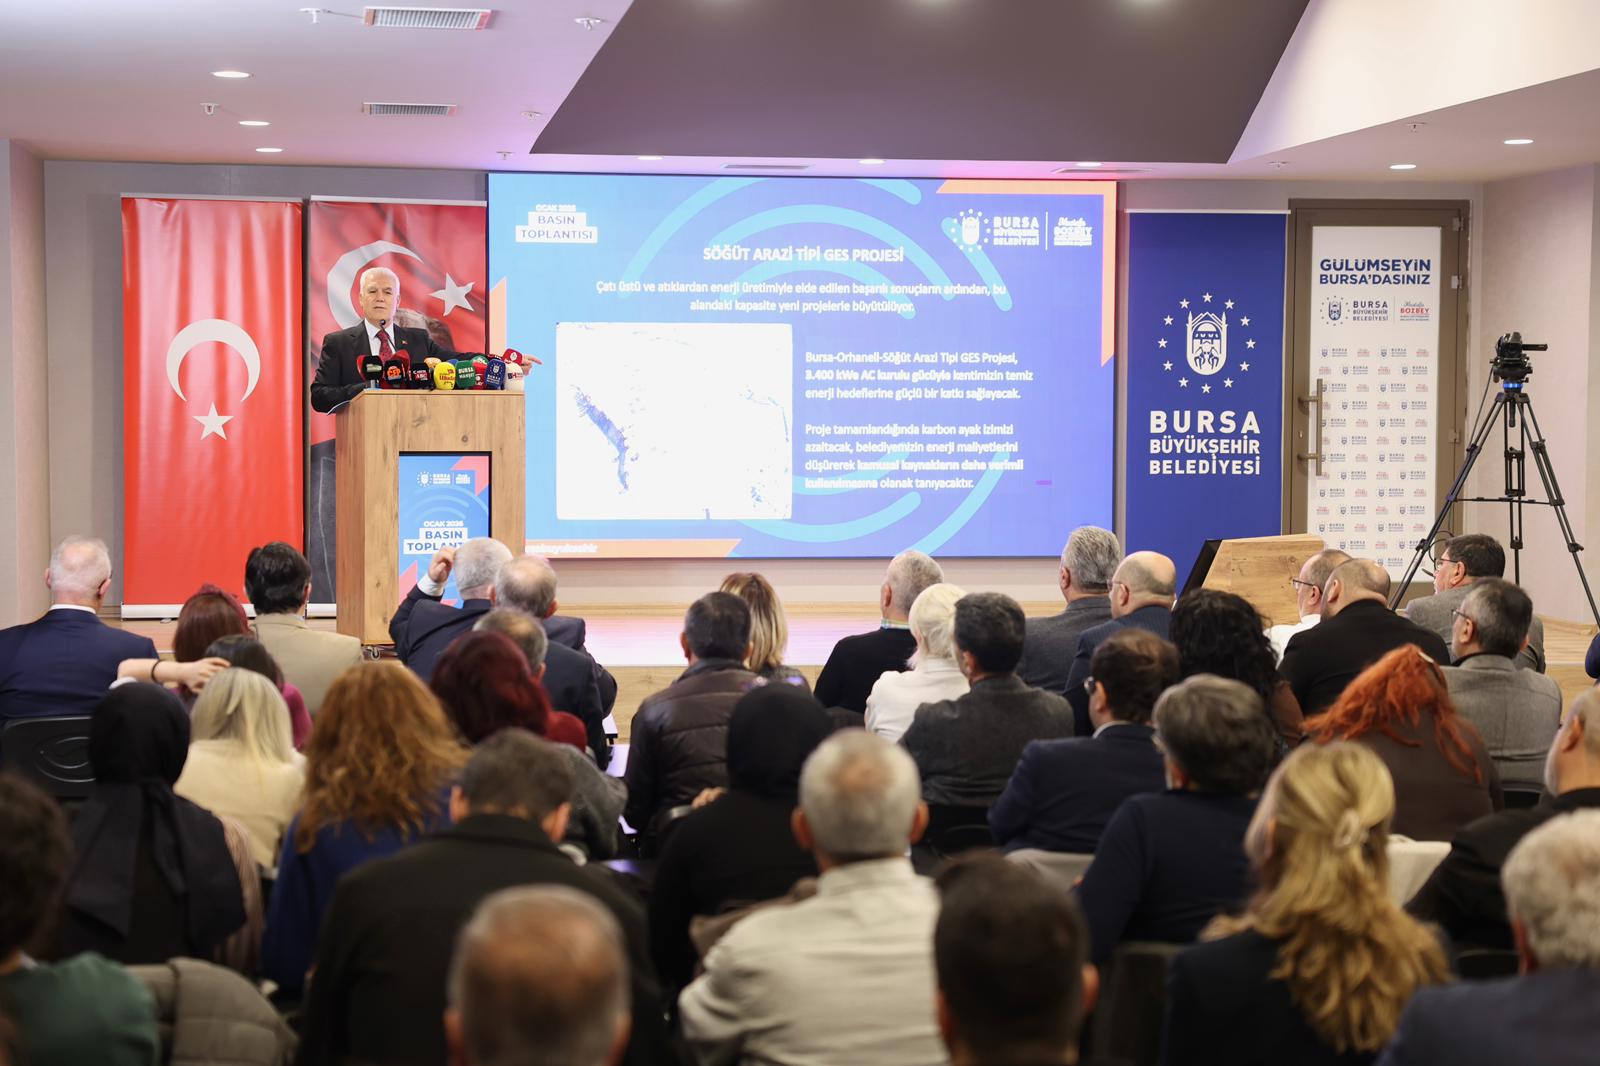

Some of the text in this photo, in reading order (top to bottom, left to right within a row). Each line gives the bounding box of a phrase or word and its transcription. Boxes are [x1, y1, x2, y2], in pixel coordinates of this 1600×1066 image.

[538, 215, 575, 225] BASIN
[993, 216, 1039, 228] BURSA
[520, 229, 593, 239] TOPLANTISI
[704, 245, 903, 262] SÖĞÜT ARAZİ TİPİ GES PROJESİ
[1320, 258, 1431, 272] GÜLÜMSEYİN
[1319, 274, 1431, 285] BURSA'DASINIZ
[597, 281, 1006, 296] Çatı üstü ve atıklardan enerji üretimiyle elde edilen başarılı sonuçların ardından, bu
[691, 299, 914, 314] alandaki kapasite yeni projelerle büyütülüyor.
[806, 351, 1017, 366] Bursa-Orhaneli-Söğüt Arazi Tipi GES Projesi,
[806, 369, 1033, 383] 3.400 kWe AC kurulu gücüyle kentimizin temiz
[806, 387, 1020, 401] enerji hedeflerine güçlü bir katkı sağlayacak.
[1150, 410, 1261, 434] BURSA
[806, 423, 1013, 437] Proje tamamlandığında karbon ayak izimizi
[805, 441, 1018, 455] azaltacak, belediyemizin enerji maliyetlerini
[1150, 435, 1260, 456] BÜYÜKŞEHİR
[805, 459, 1023, 473] düşürerek kamusal kaynakların daha verimli
[1149, 456, 1260, 475] BELEDİYESİ
[805, 478, 973, 491] kullanılmasına olanak tanıyacaktır.
[425, 531, 463, 539] BASIN
[407, 542, 464, 551] TOPLAN
